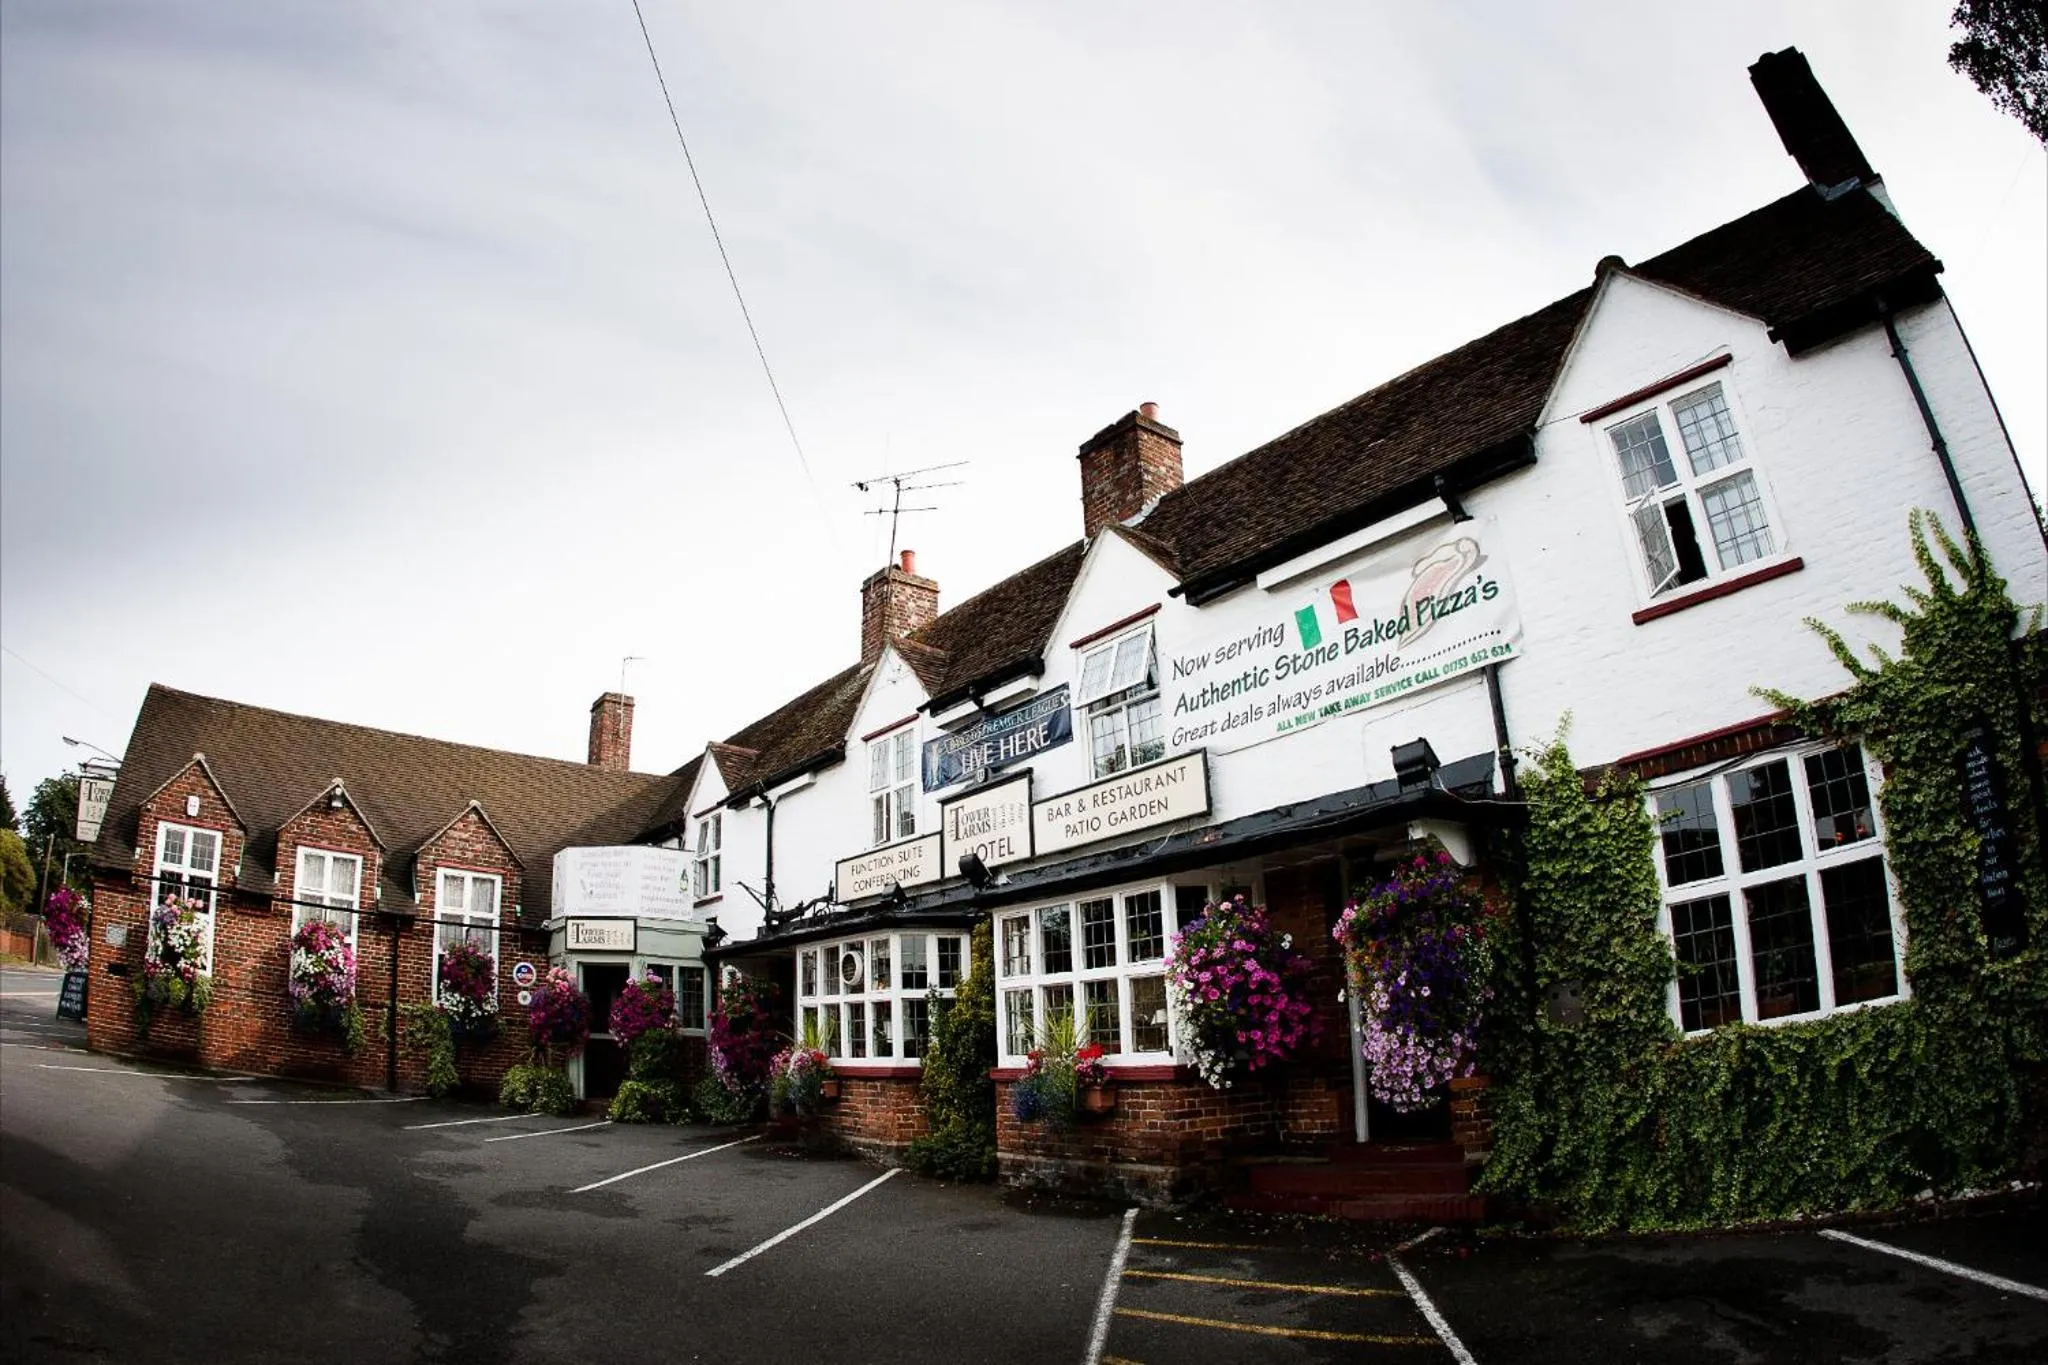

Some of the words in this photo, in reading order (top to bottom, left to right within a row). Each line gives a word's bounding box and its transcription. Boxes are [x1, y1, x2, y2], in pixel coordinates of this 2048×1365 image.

[1172, 653, 1211, 681] Now
[1215, 623, 1285, 665] serving
[1173, 665, 1270, 718] Authentic
[1274, 642, 1339, 681] Stone
[1344, 604, 1411, 655] Baked
[1415, 574, 1499, 627] Pizza's
[1276, 719, 1293, 732] ALL
[1295, 710, 1316, 727] NEW
[1318, 700, 1342, 718] TAKE
[1344, 692, 1371, 709] AWAY
[1374, 676, 1412, 700] SERVICE
[1414, 667, 1441, 685] CALL
[1490, 642, 1513, 658] 624
[1172, 721, 1217, 747] Great
[1220, 703, 1264, 733] deals
[1267, 684, 1322, 718] always
[961, 742, 994, 776] LIVE
[999, 722, 1052, 762] HERE
[1046, 803, 1072, 823] BAR
[1077, 798, 1087, 814] &
[1092, 766, 1188, 810] RESTAURANT
[1064, 816, 1102, 839] PATIO
[1107, 796, 1170, 828] GARDEN
[949, 805, 990, 841] TOWER
[963, 819, 991, 840] ARMS
[851, 853, 894, 877] FUNCTION
[897, 845, 923, 864] SUITE
[852, 865, 921, 894] CONFERENCING
